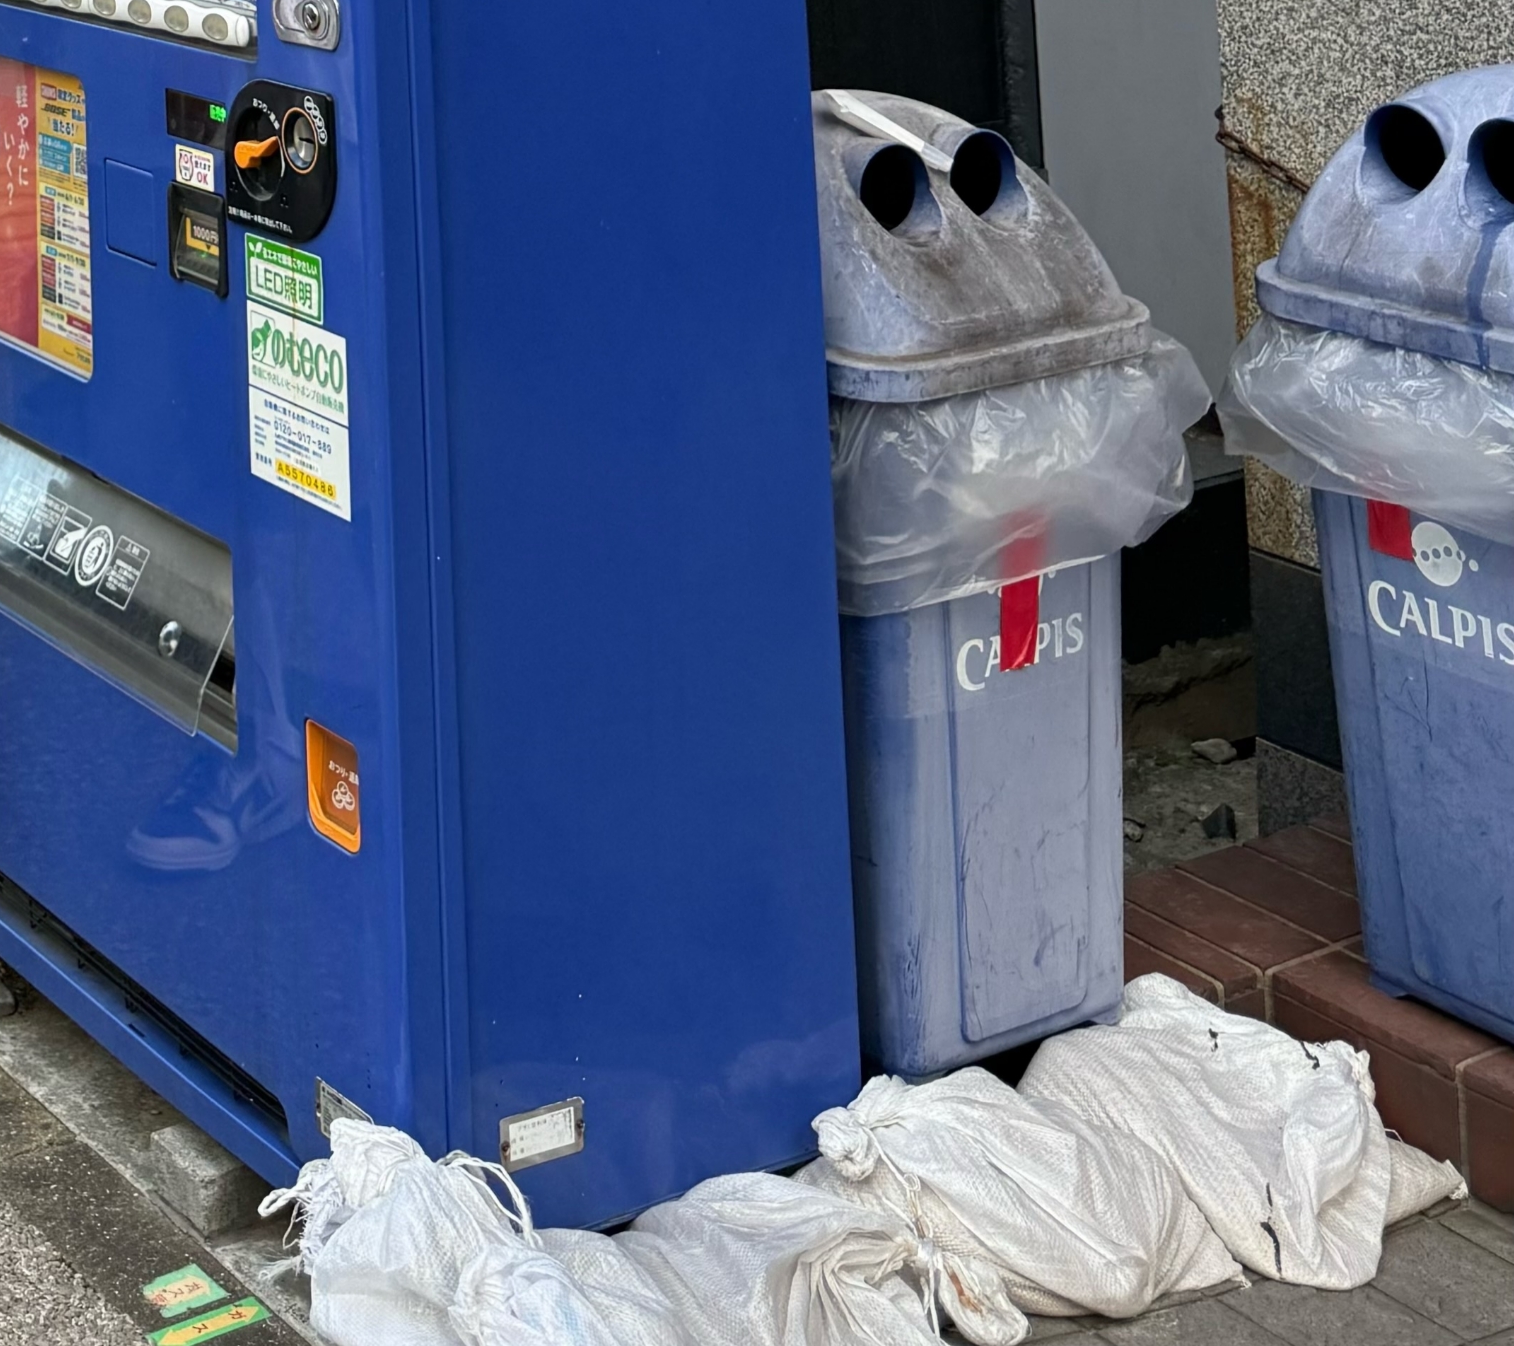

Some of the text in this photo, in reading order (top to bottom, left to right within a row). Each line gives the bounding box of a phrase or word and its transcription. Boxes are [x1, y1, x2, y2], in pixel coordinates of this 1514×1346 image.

[16, 84, 30, 186] 軽やかに
[197, 172, 208, 185] OK
[256, 264, 313, 310] LED照明
[271, 329, 344, 394] のむeco
[957, 612, 1084, 691] CAPIS
[1369, 578, 1514, 665] CALPIS
